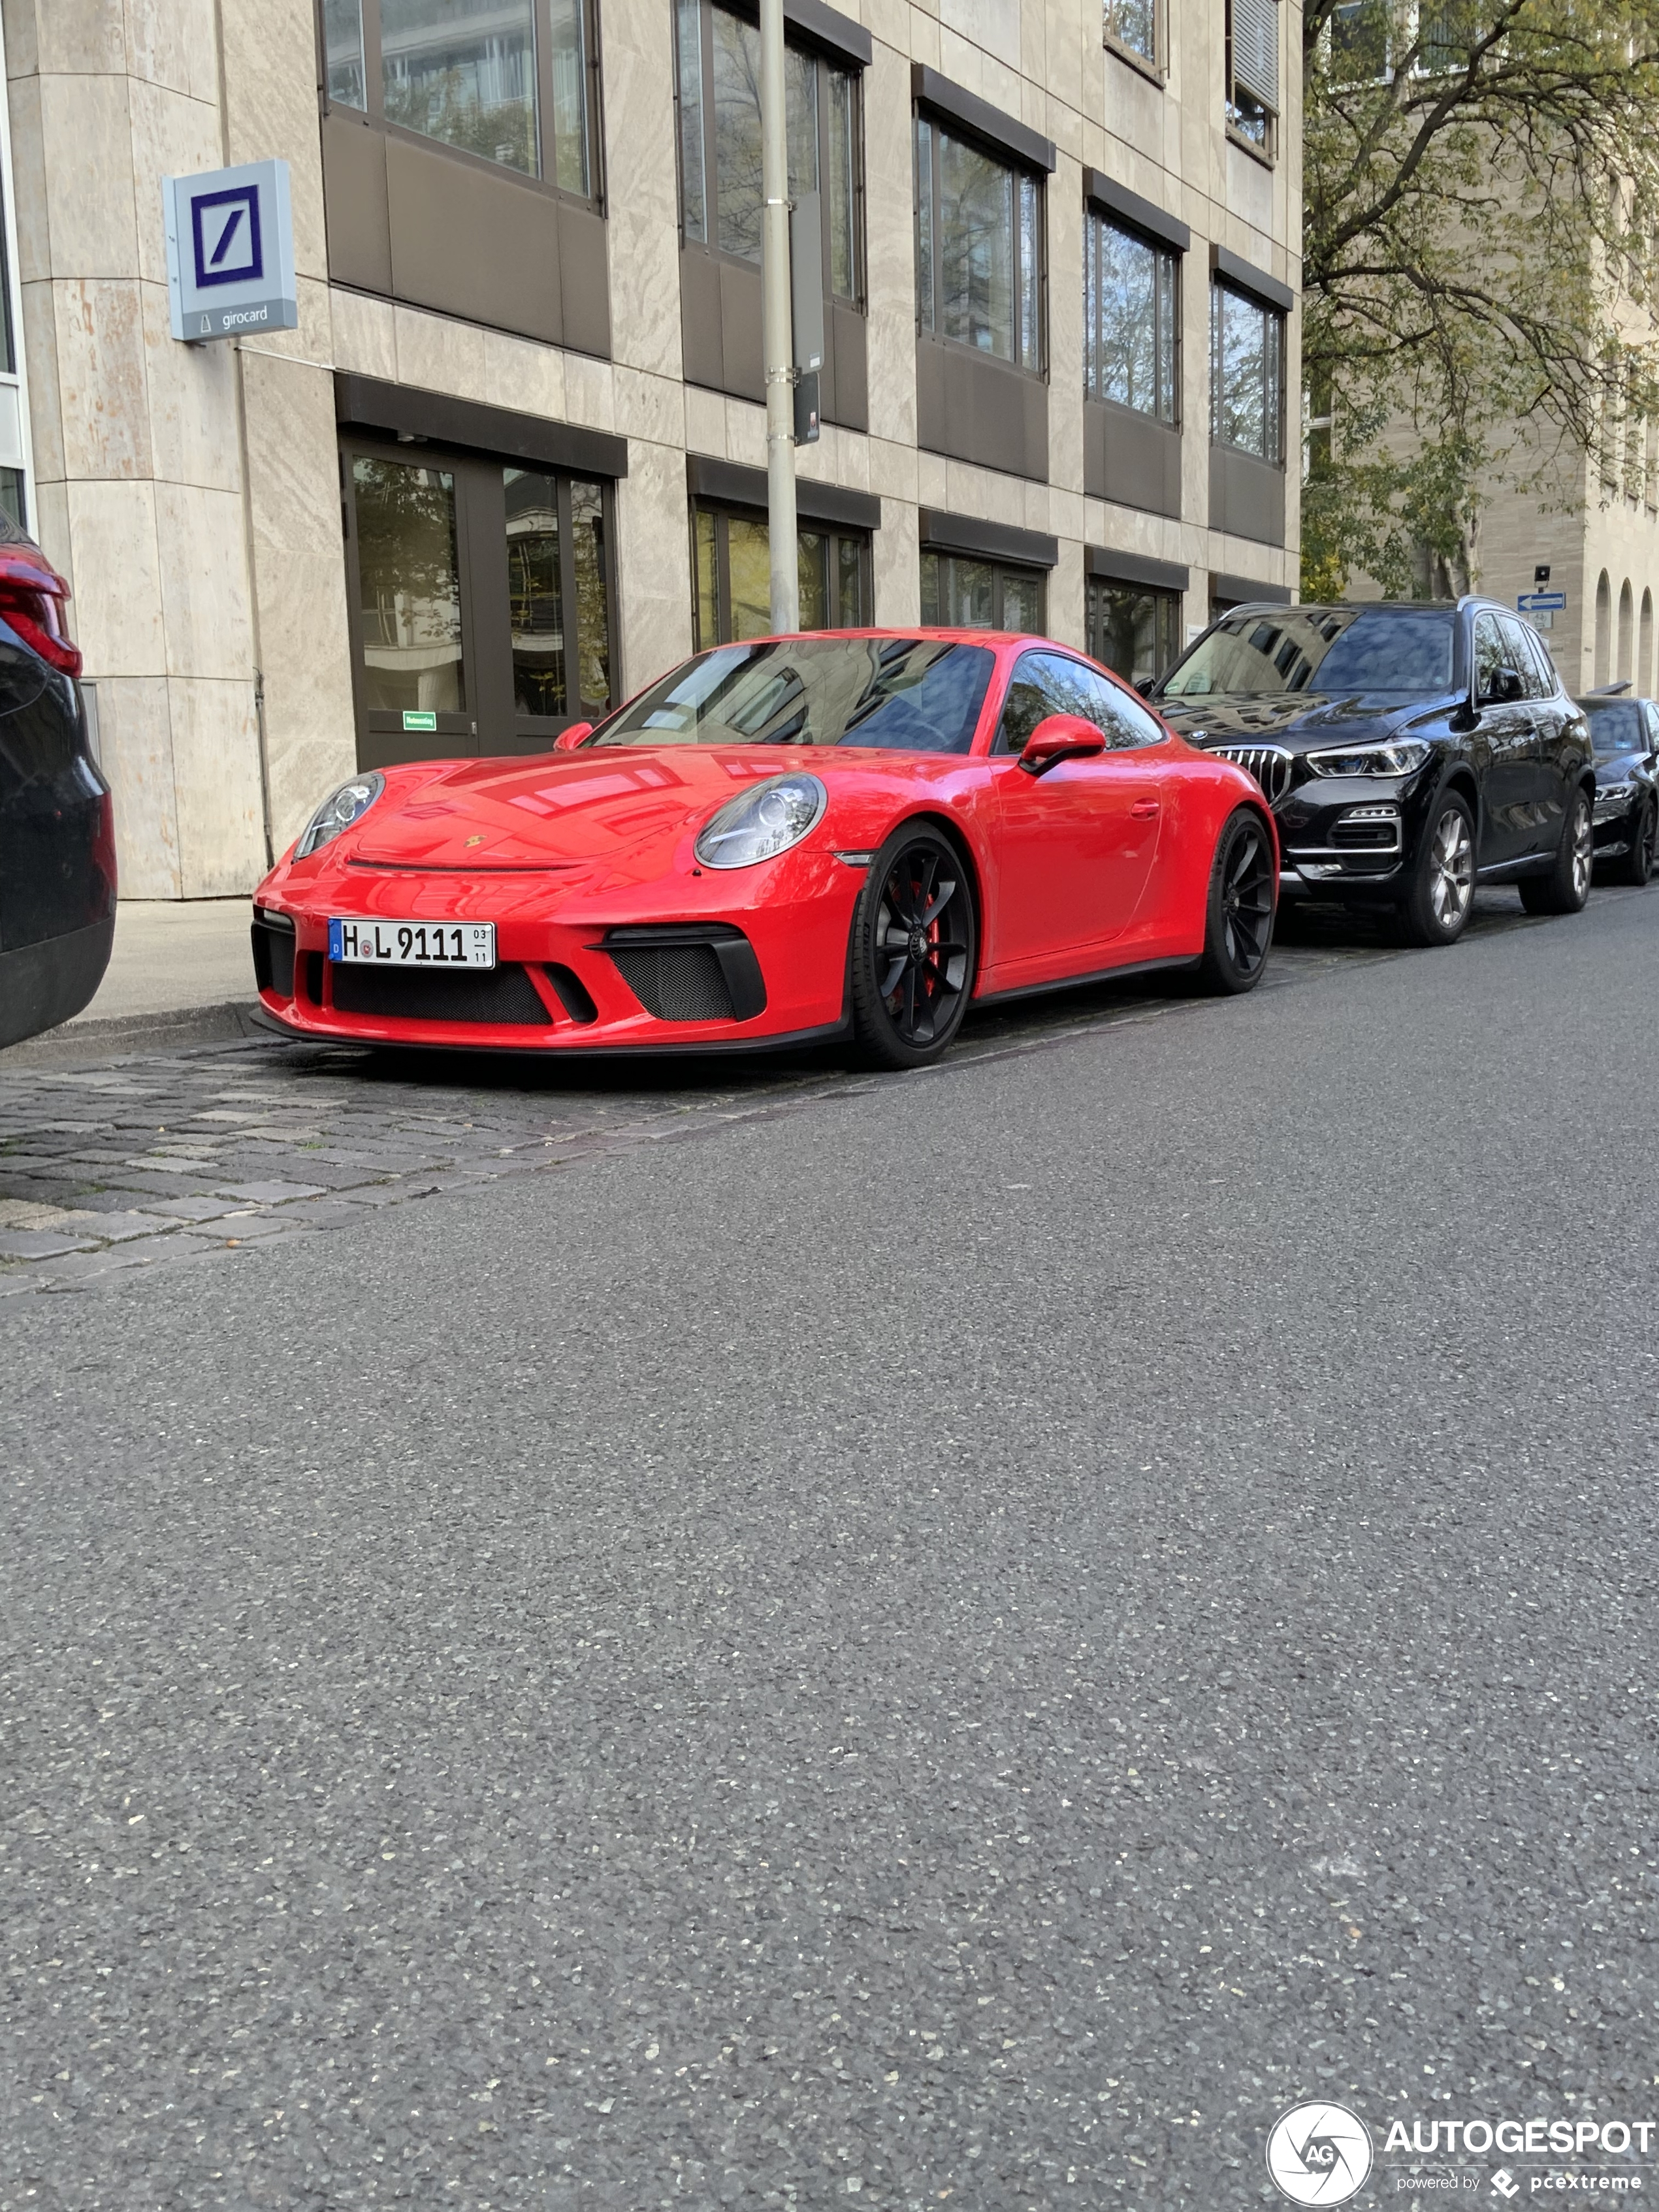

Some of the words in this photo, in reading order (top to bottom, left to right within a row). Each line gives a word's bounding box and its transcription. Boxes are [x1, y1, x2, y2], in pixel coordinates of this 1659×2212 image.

[223, 305, 268, 329] girocard
[474, 929, 487, 939] 03
[343, 925, 358, 956] H
[375, 926, 391, 959] L
[398, 927, 468, 961] 9111
[334, 944, 339, 953] D
[475, 952, 487, 962] 11
